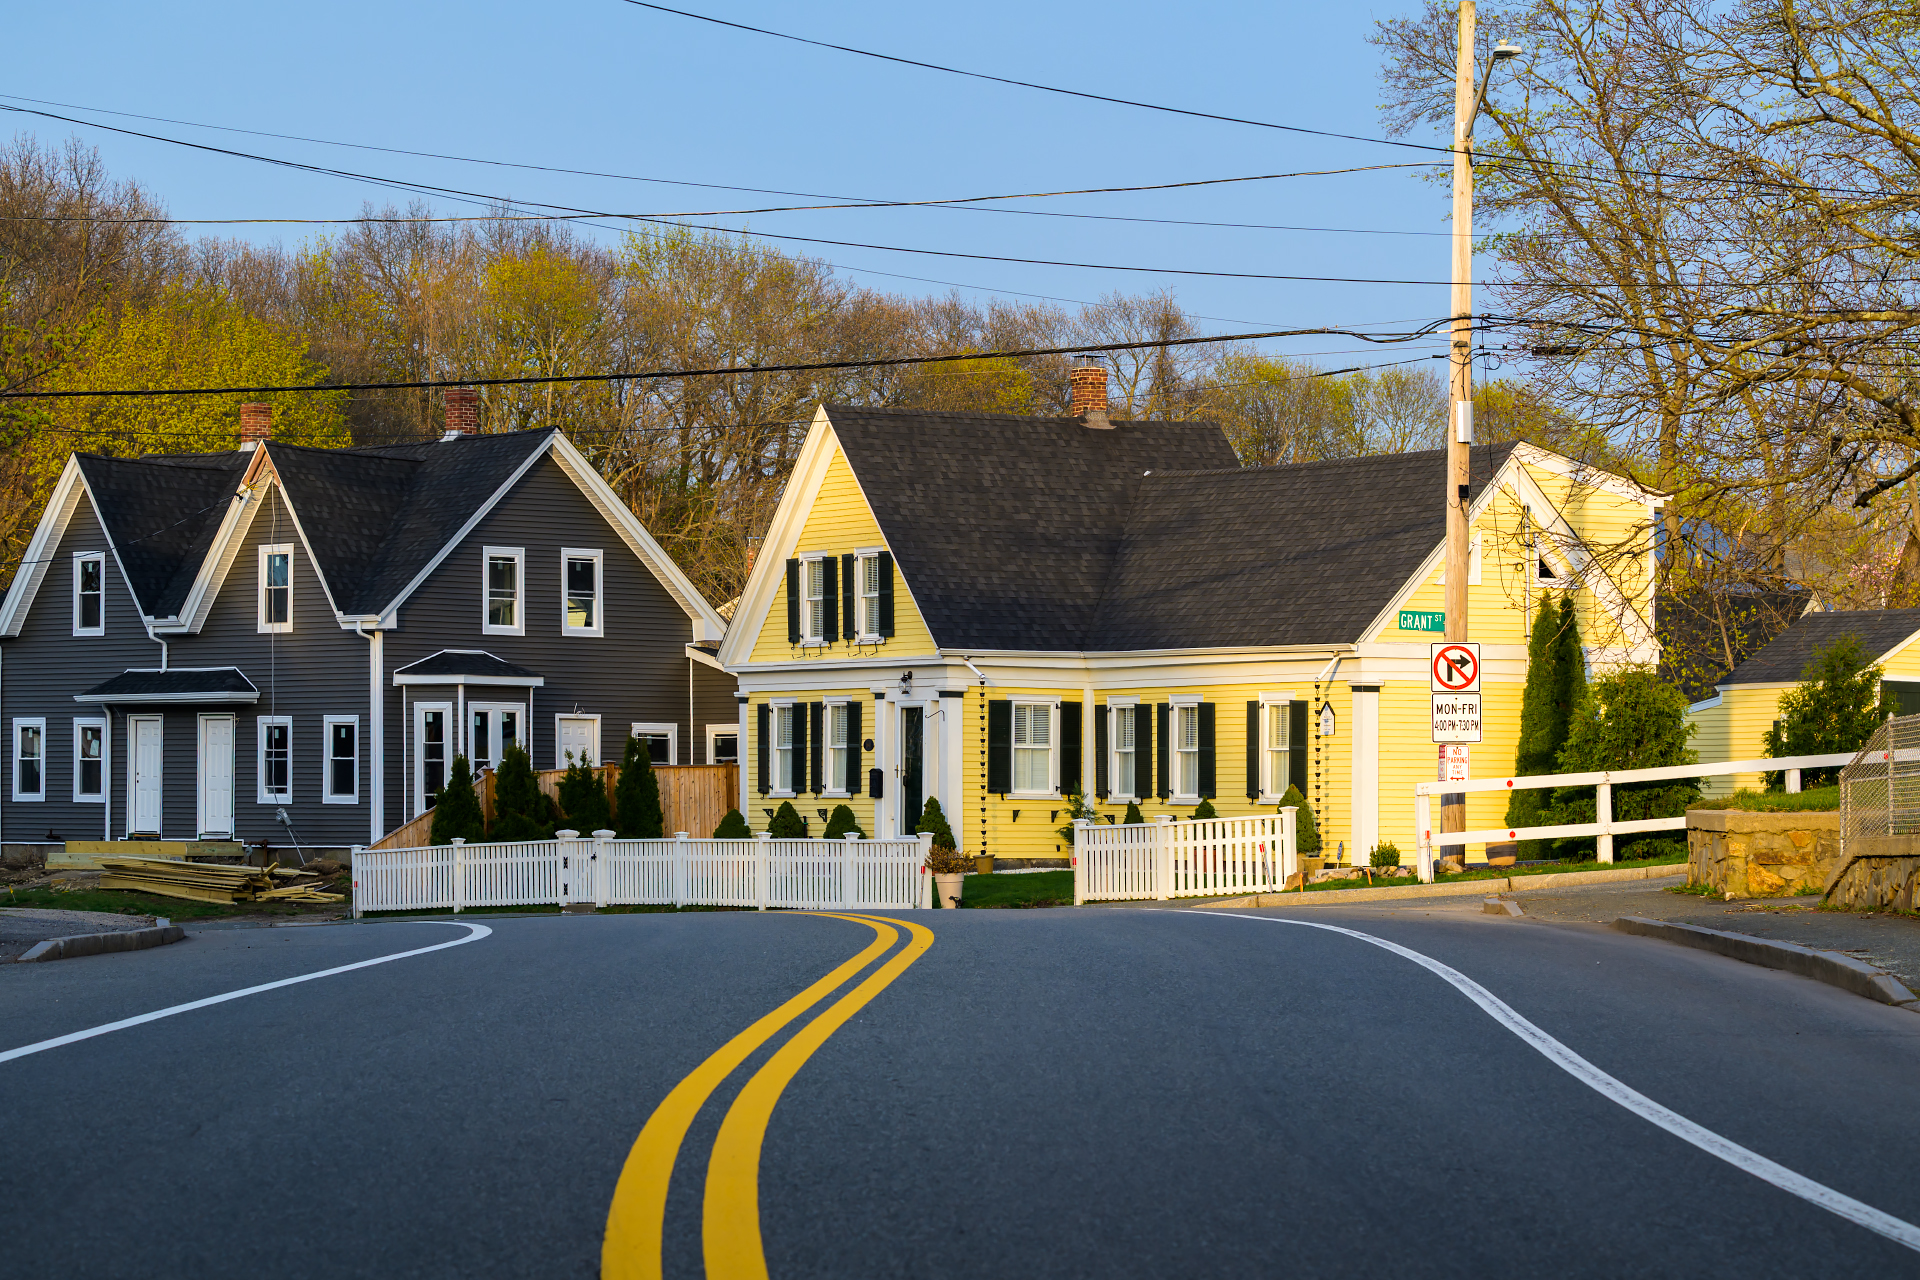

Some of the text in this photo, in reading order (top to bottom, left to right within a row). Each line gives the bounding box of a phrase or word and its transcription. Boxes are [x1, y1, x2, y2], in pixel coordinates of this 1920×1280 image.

[1401, 614, 1442, 629] GRANT ST
[1436, 704, 1477, 714] MON-FRI
[1471, 720, 1479, 731] PM
